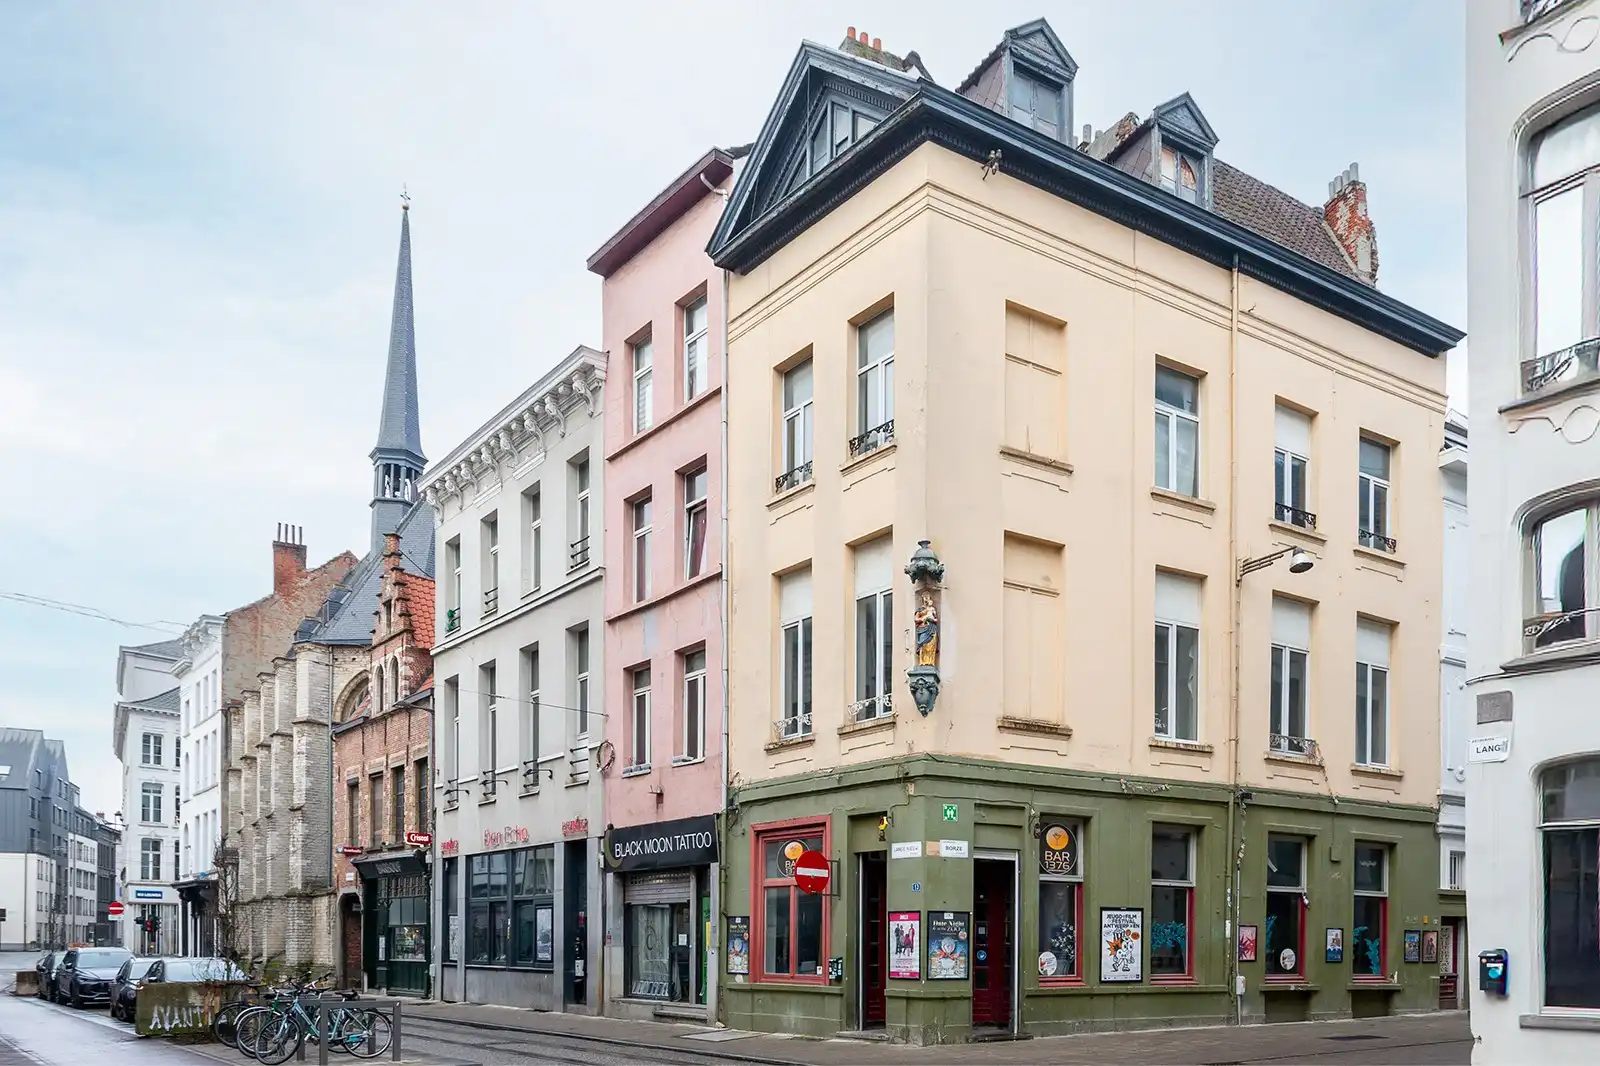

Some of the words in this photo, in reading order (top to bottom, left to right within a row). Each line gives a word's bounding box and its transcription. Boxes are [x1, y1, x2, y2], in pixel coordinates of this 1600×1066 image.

[614, 840, 643, 858] BLACK
[644, 836, 673, 854] MOON
[674, 831, 712, 851] TATTOO
[1044, 850, 1070, 862] BAR
[785, 860, 796, 869] BA
[1044, 861, 1070, 870] 1376
